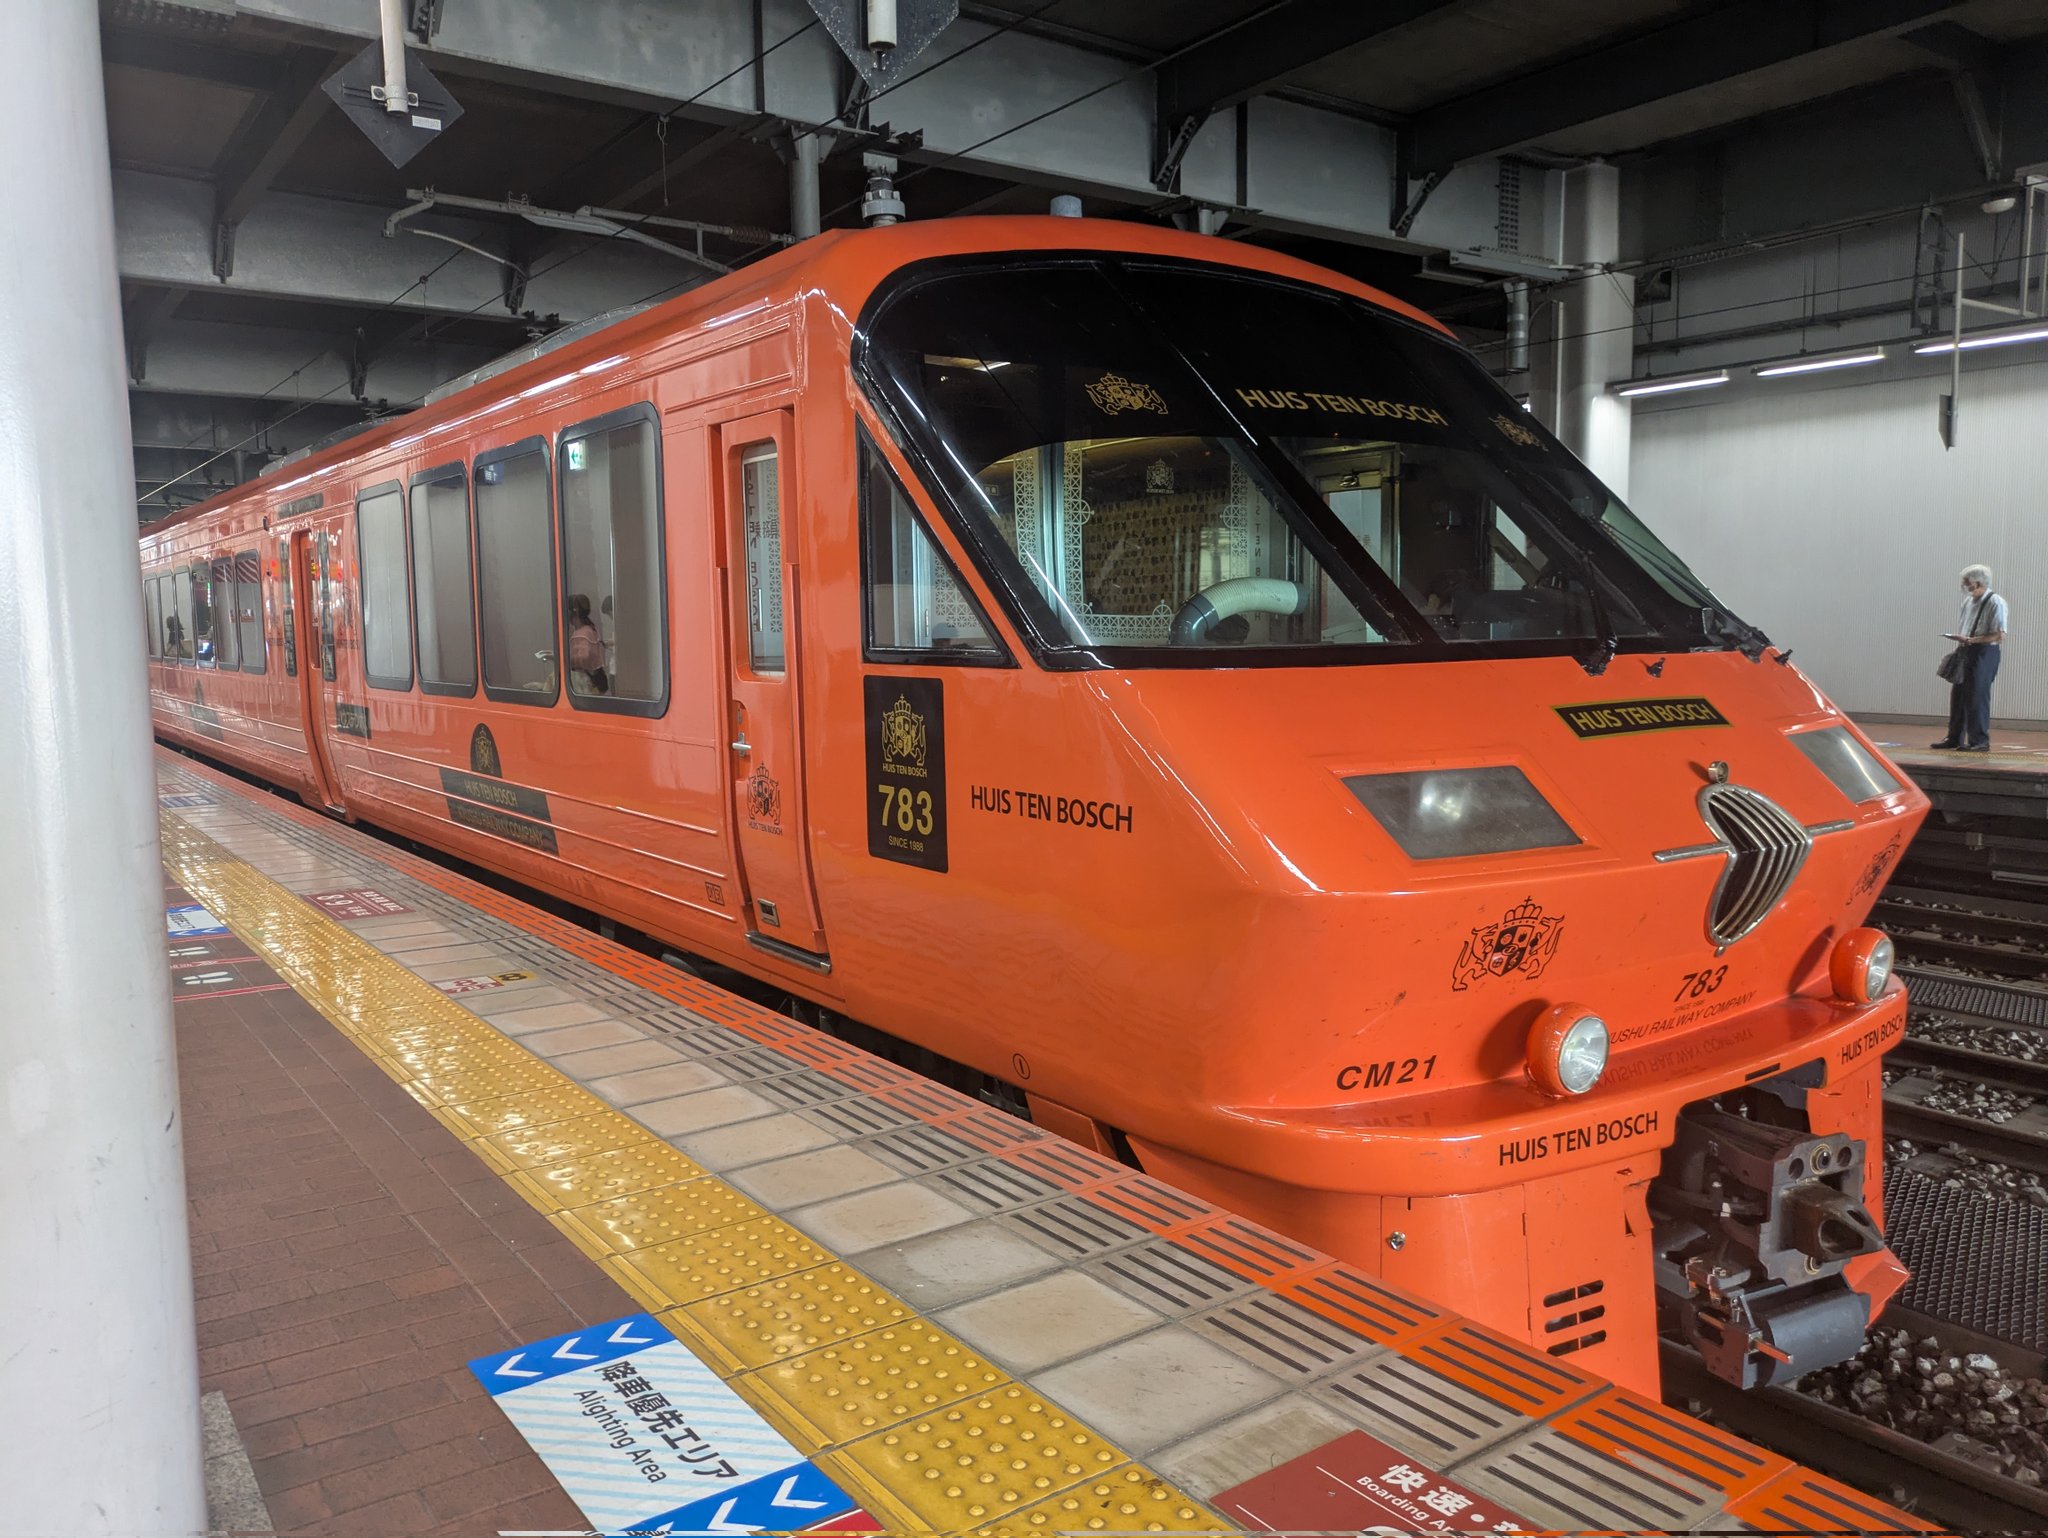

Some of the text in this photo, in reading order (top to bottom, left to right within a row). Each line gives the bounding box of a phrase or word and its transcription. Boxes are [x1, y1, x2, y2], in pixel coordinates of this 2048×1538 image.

[1236, 389, 1449, 426] HUIS TEN BOSCH
[1570, 703, 1718, 732] HUIS TEN BOSCH
[882, 762, 928, 778] HUIS TEN BOSCH
[463, 779, 519, 807] HUIS TEN BOSCH
[878, 783, 934, 836] 783
[971, 784, 1133, 834] HUIS TEN BOSCH
[888, 835, 924, 853] SINCE 1988
[1673, 964, 1729, 1003] 783
[1608, 990, 1758, 1045] USHU RAILWAY COMPANY
[1842, 1037, 1862, 1065] HUIS
[1864, 1028, 1879, 1052] TEN
[1336, 1055, 1437, 1090] CM21
[1499, 1110, 1659, 1166] HUIS TEN BOSCH
[573, 1389, 636, 1450] Alighting
[625, 1448, 668, 1484] Area
[593, 1360, 739, 1478] 降車優先エリア
[1356, 1475, 1430, 1522] Boarding
